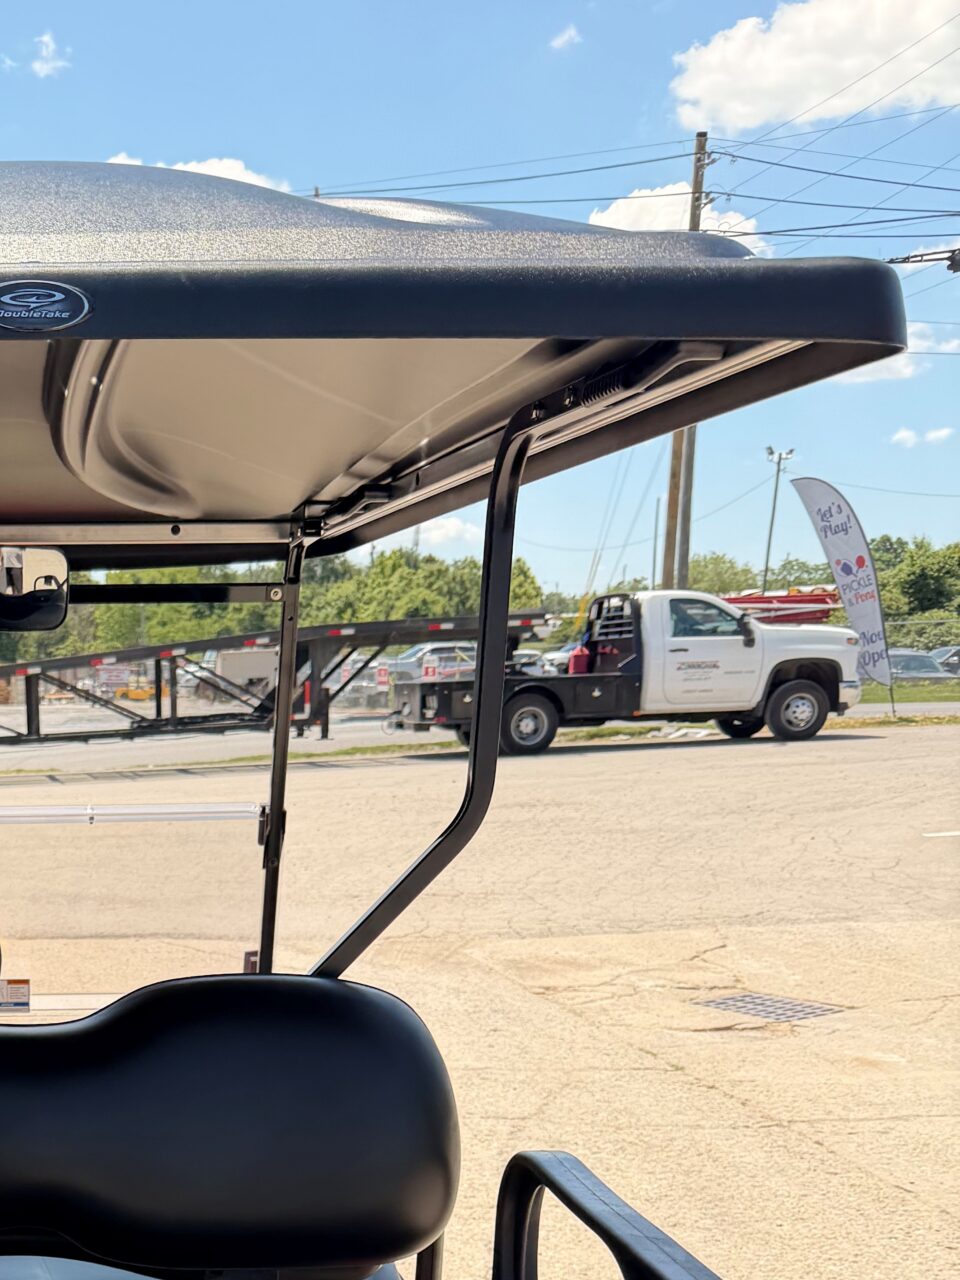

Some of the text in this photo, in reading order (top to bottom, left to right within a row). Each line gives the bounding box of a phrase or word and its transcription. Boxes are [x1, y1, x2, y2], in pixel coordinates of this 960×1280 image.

[816, 502, 843, 523] Let's
[820, 514, 853, 539] Play!
[841, 574, 873, 595] PICKLE
